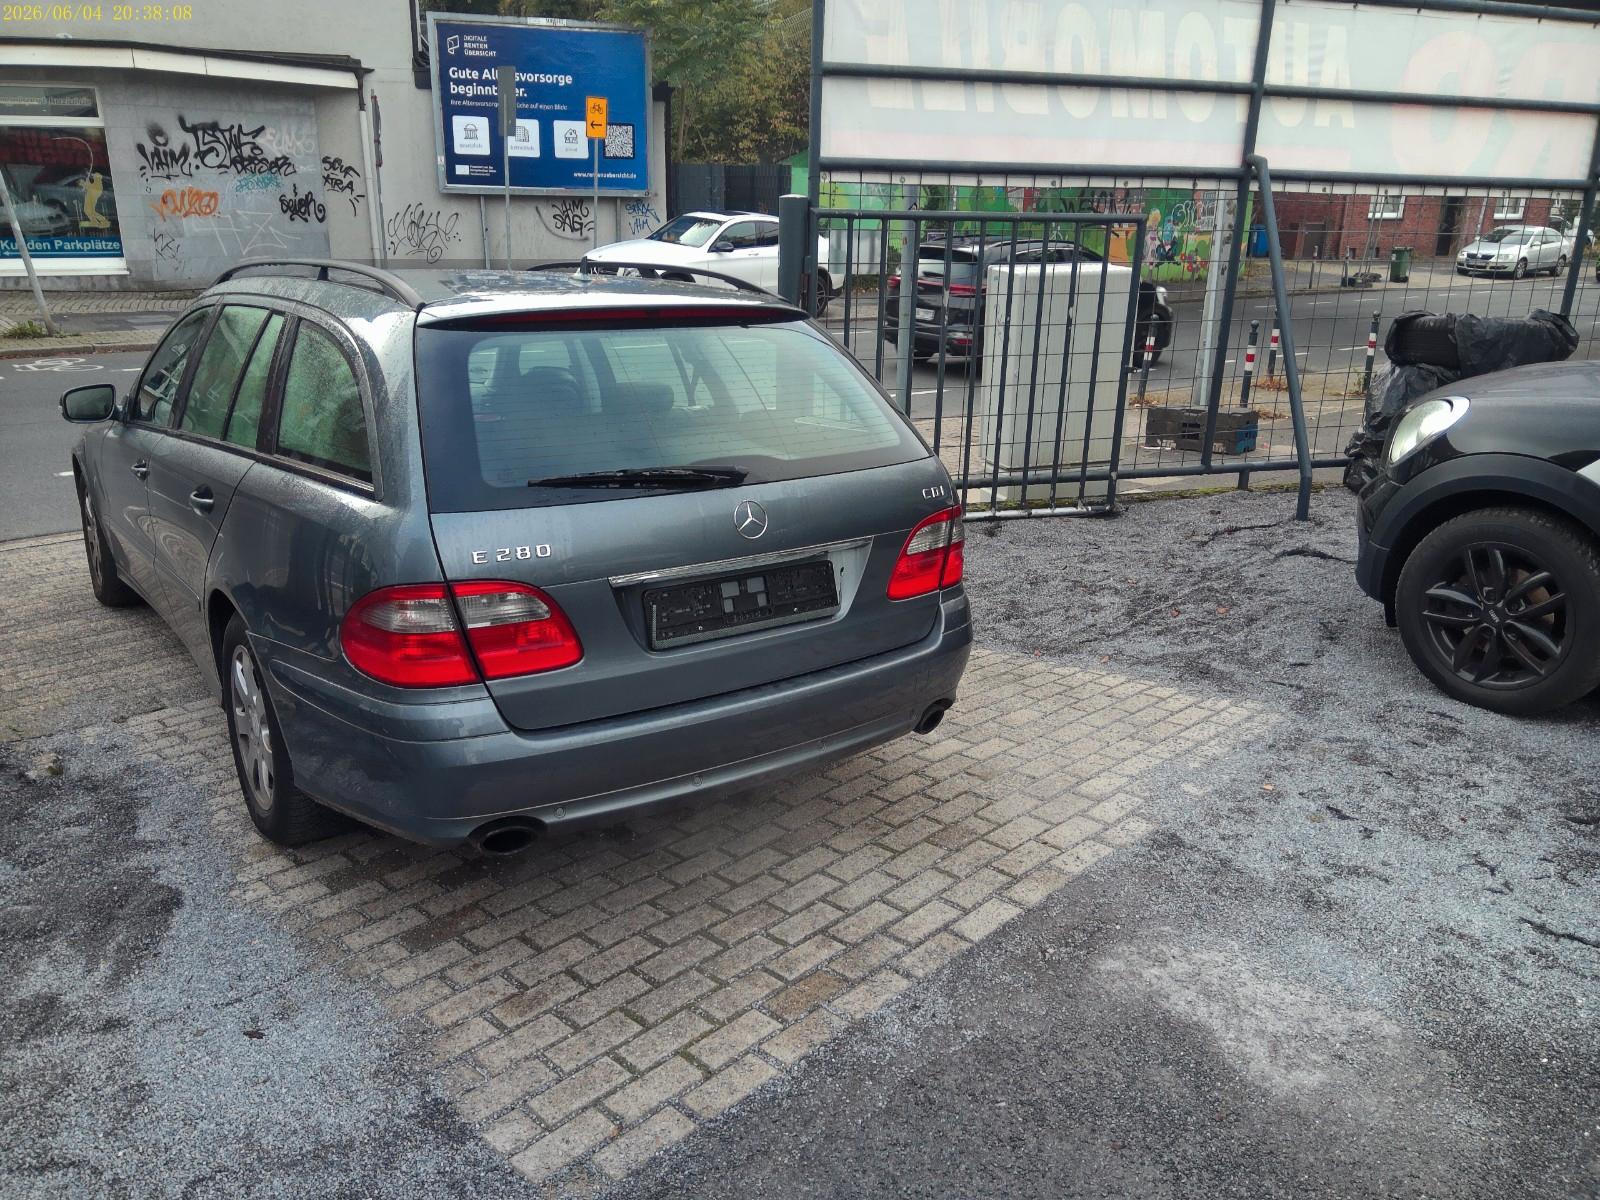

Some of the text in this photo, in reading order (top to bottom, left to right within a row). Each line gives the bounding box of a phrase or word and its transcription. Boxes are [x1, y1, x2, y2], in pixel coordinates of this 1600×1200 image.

[464, 48, 496, 57] ÜBERSICHT
[449, 66, 478, 79] Gute
[450, 82, 498, 97] beginnt
[0, 239, 120, 252] Kuden Parkplätze
[922, 485, 945, 499] CDI
[471, 543, 551, 565] E 280
